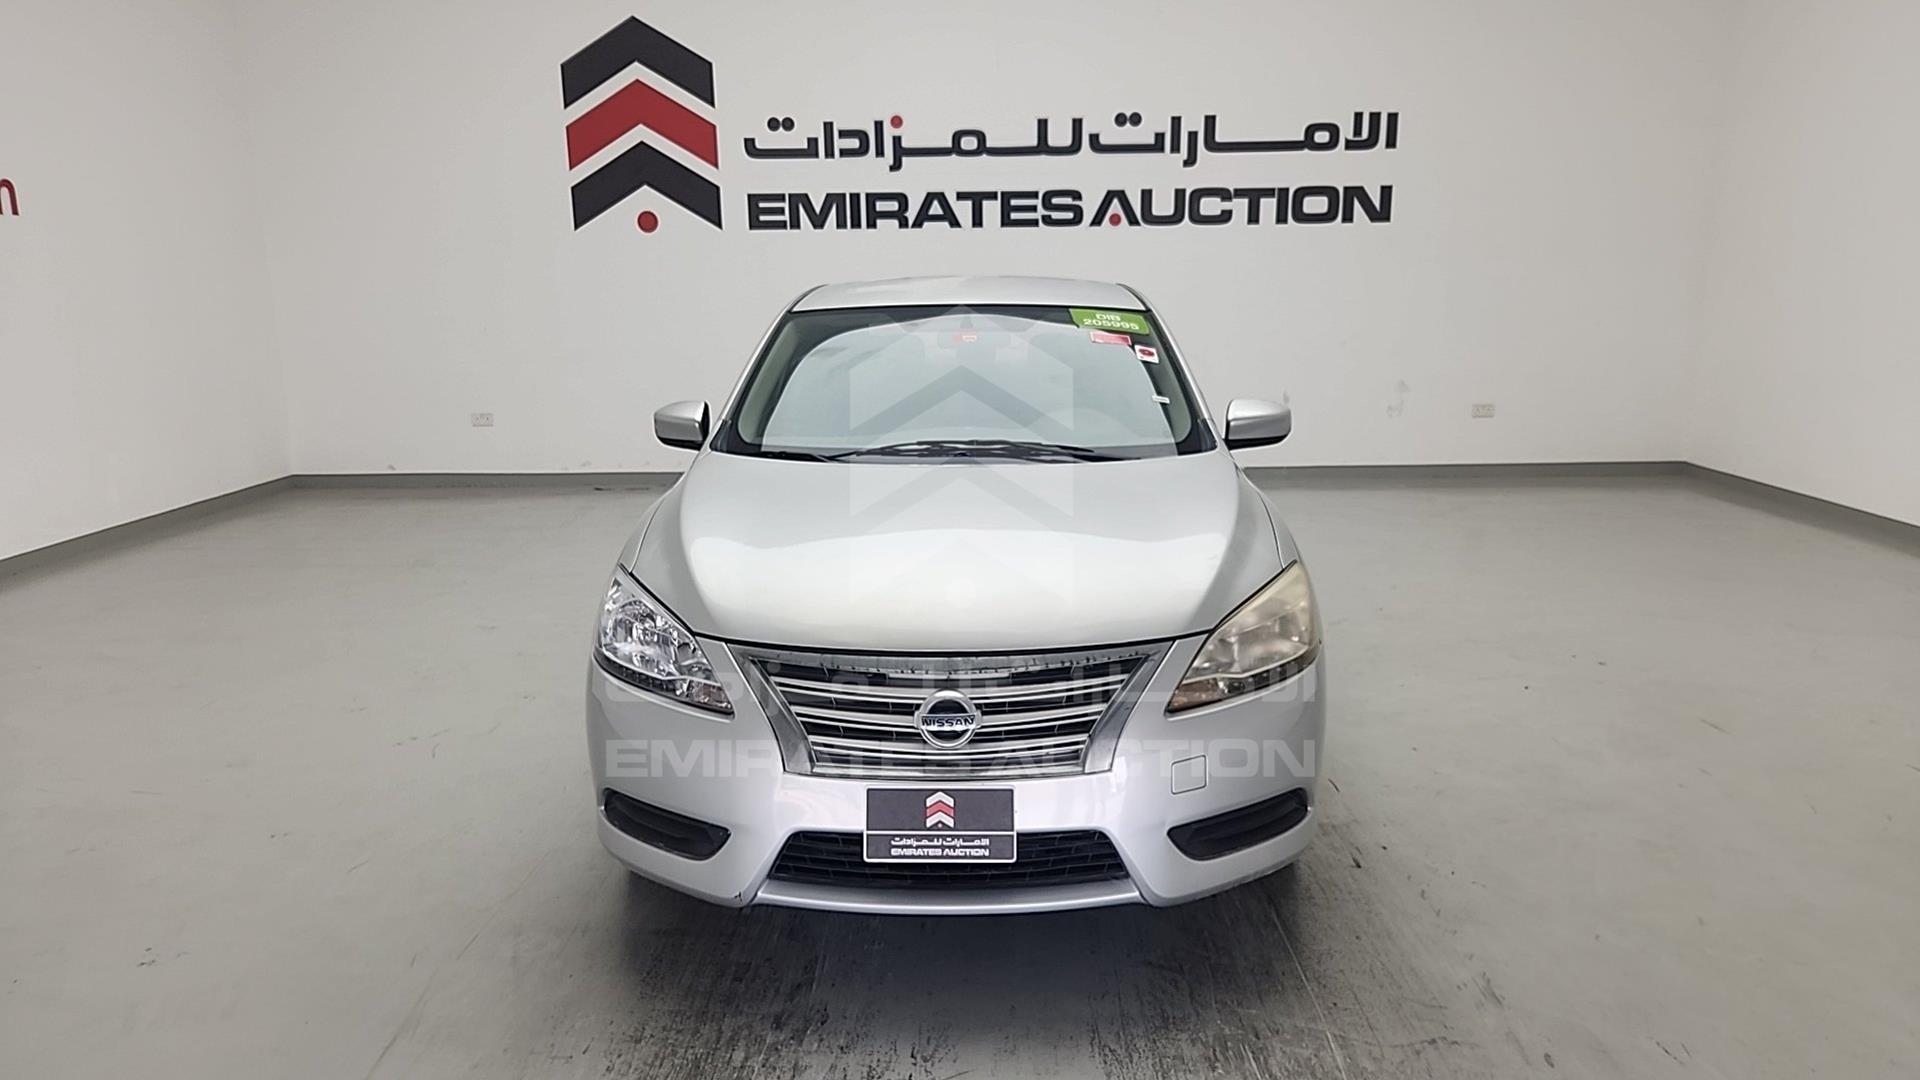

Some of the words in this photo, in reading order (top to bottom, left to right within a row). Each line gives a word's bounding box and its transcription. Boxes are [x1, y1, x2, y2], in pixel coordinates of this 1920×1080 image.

[747, 189, 1084, 231] EMIRATES
[1089, 185, 1393, 227] AUCTION
[921, 715, 975, 727] NISSAN
[890, 848, 942, 857] EMIRATES
[943, 848, 990, 857] AUCTION
